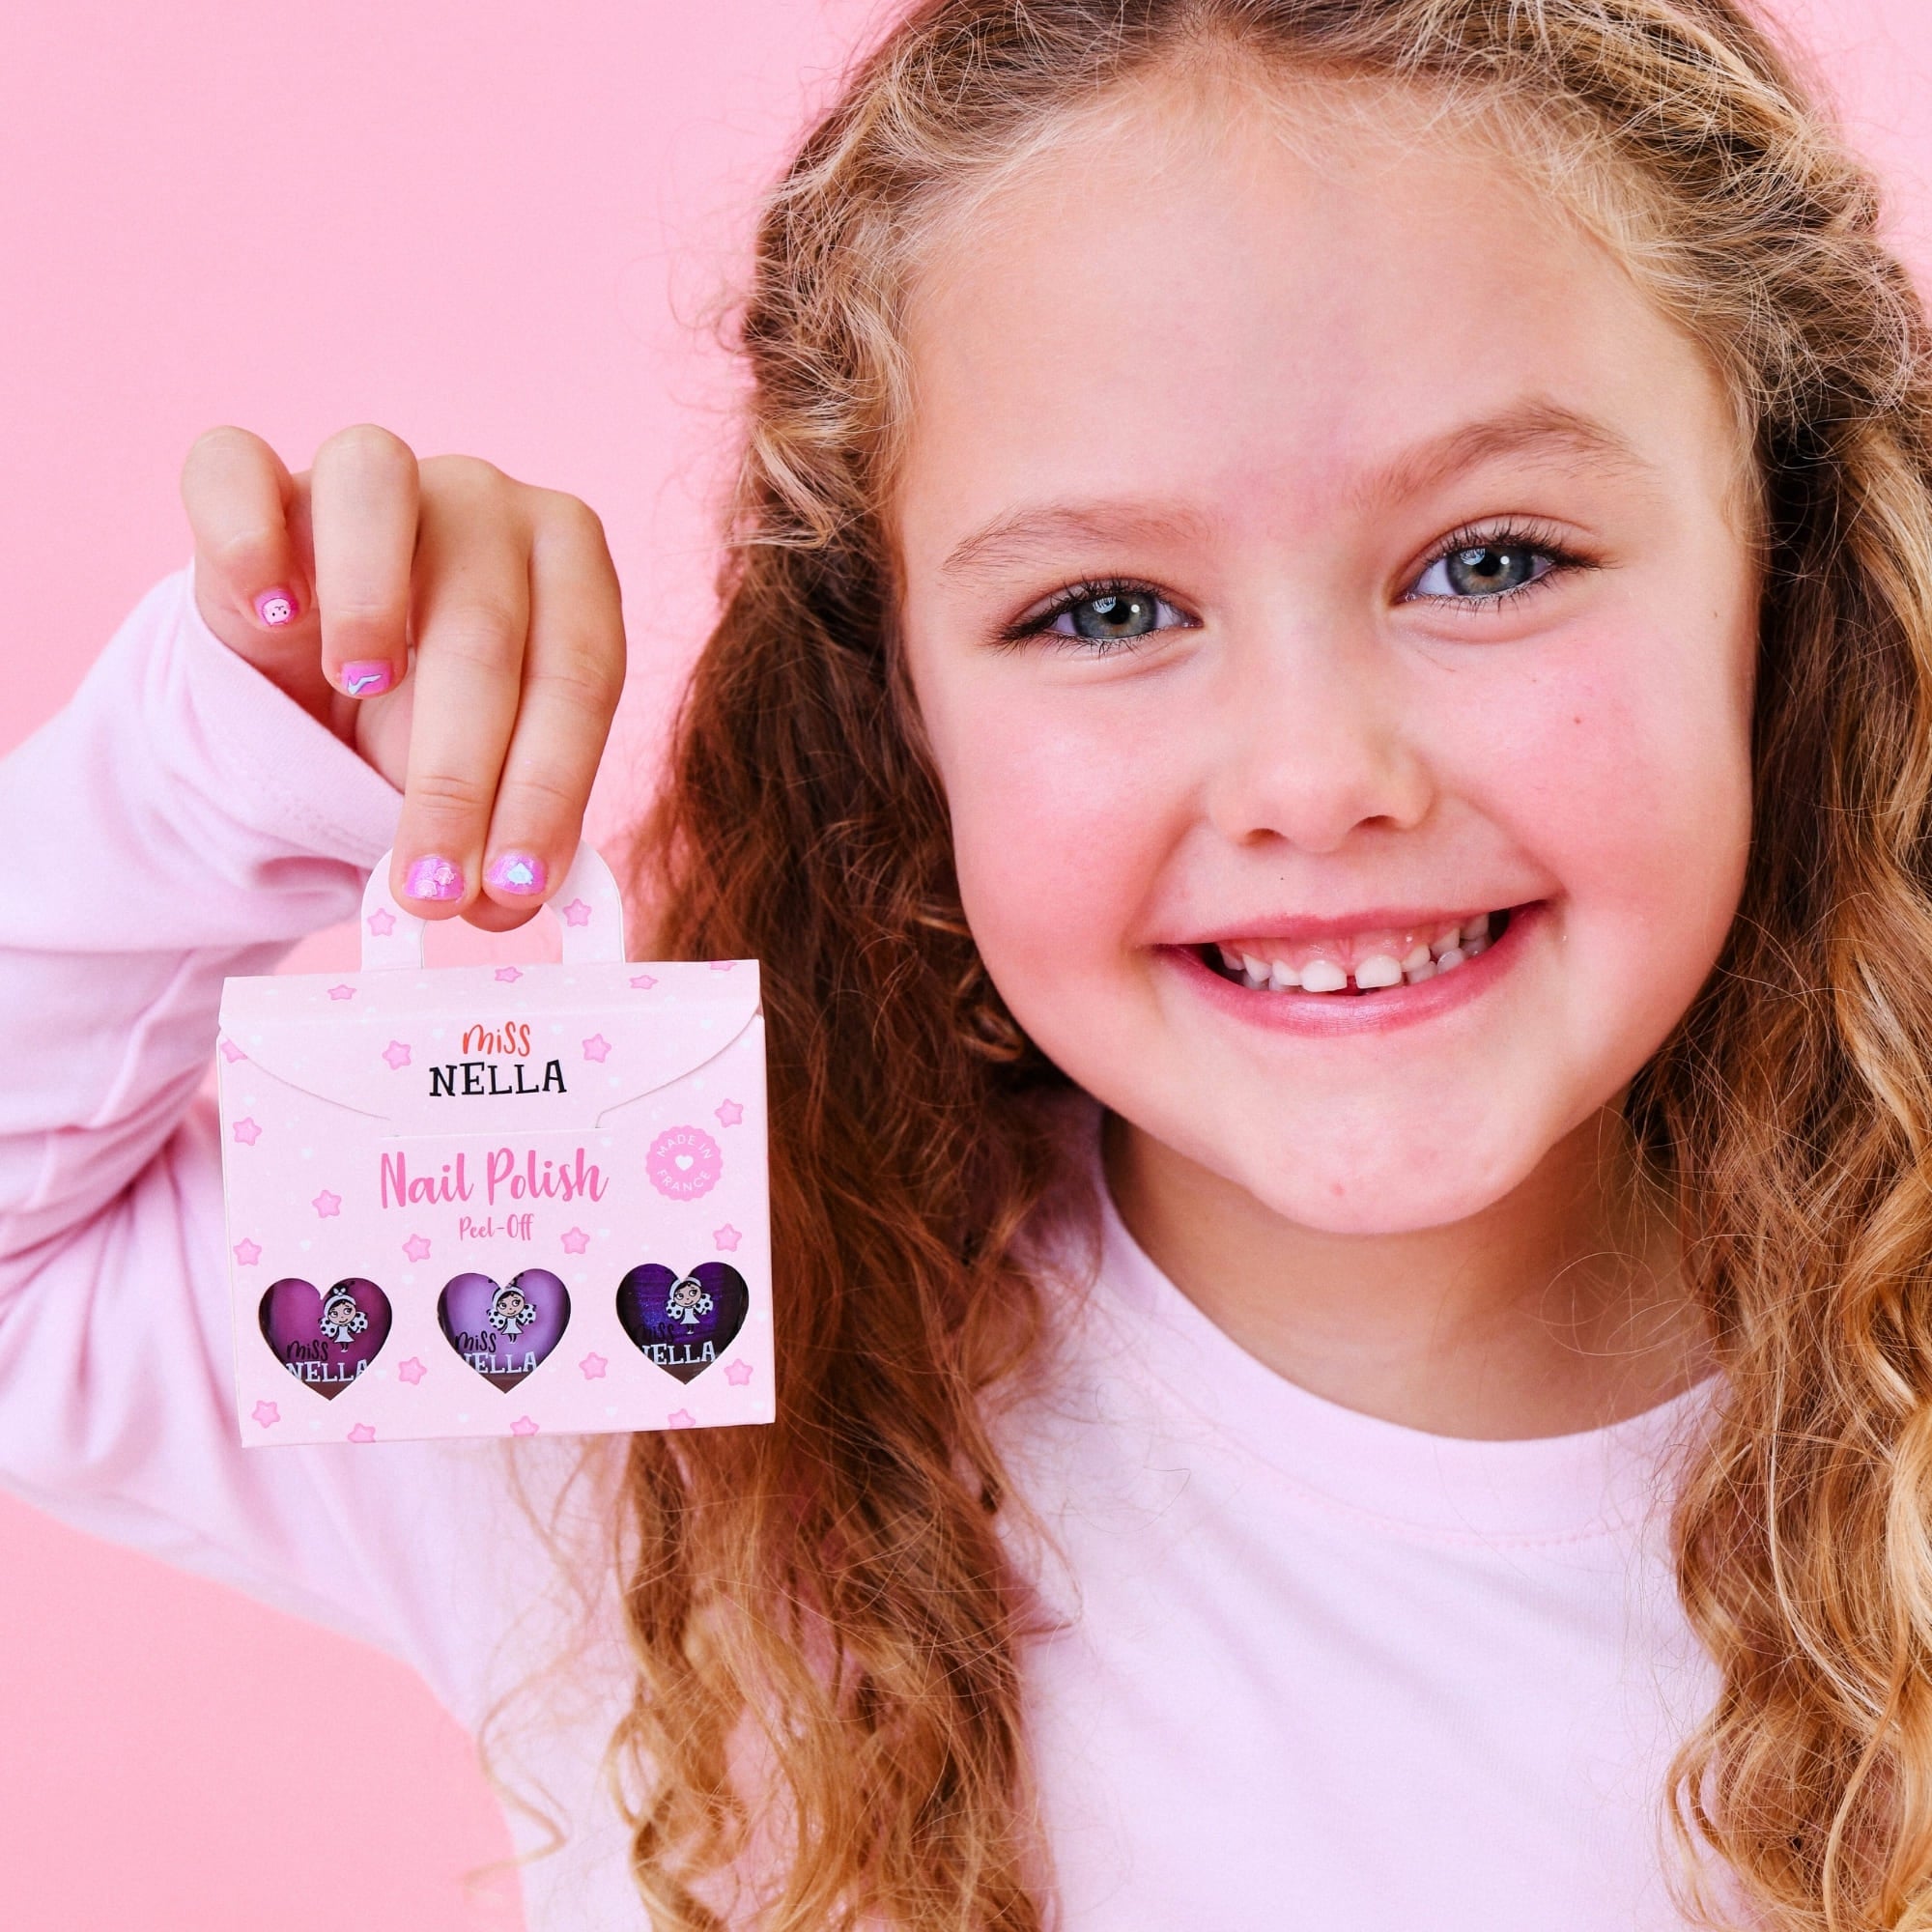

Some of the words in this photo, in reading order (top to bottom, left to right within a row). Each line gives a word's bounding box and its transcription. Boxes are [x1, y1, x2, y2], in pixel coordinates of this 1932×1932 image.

[429, 1060, 567, 1096] NELLA
[657, 1134, 696, 1158] MADE
[698, 1144, 712, 1159] IN
[381, 1151, 474, 1208] Nail
[487, 1148, 610, 1207] Polish
[658, 1169, 711, 1191] FRANCE
[459, 1213, 534, 1241] Peel-Off
